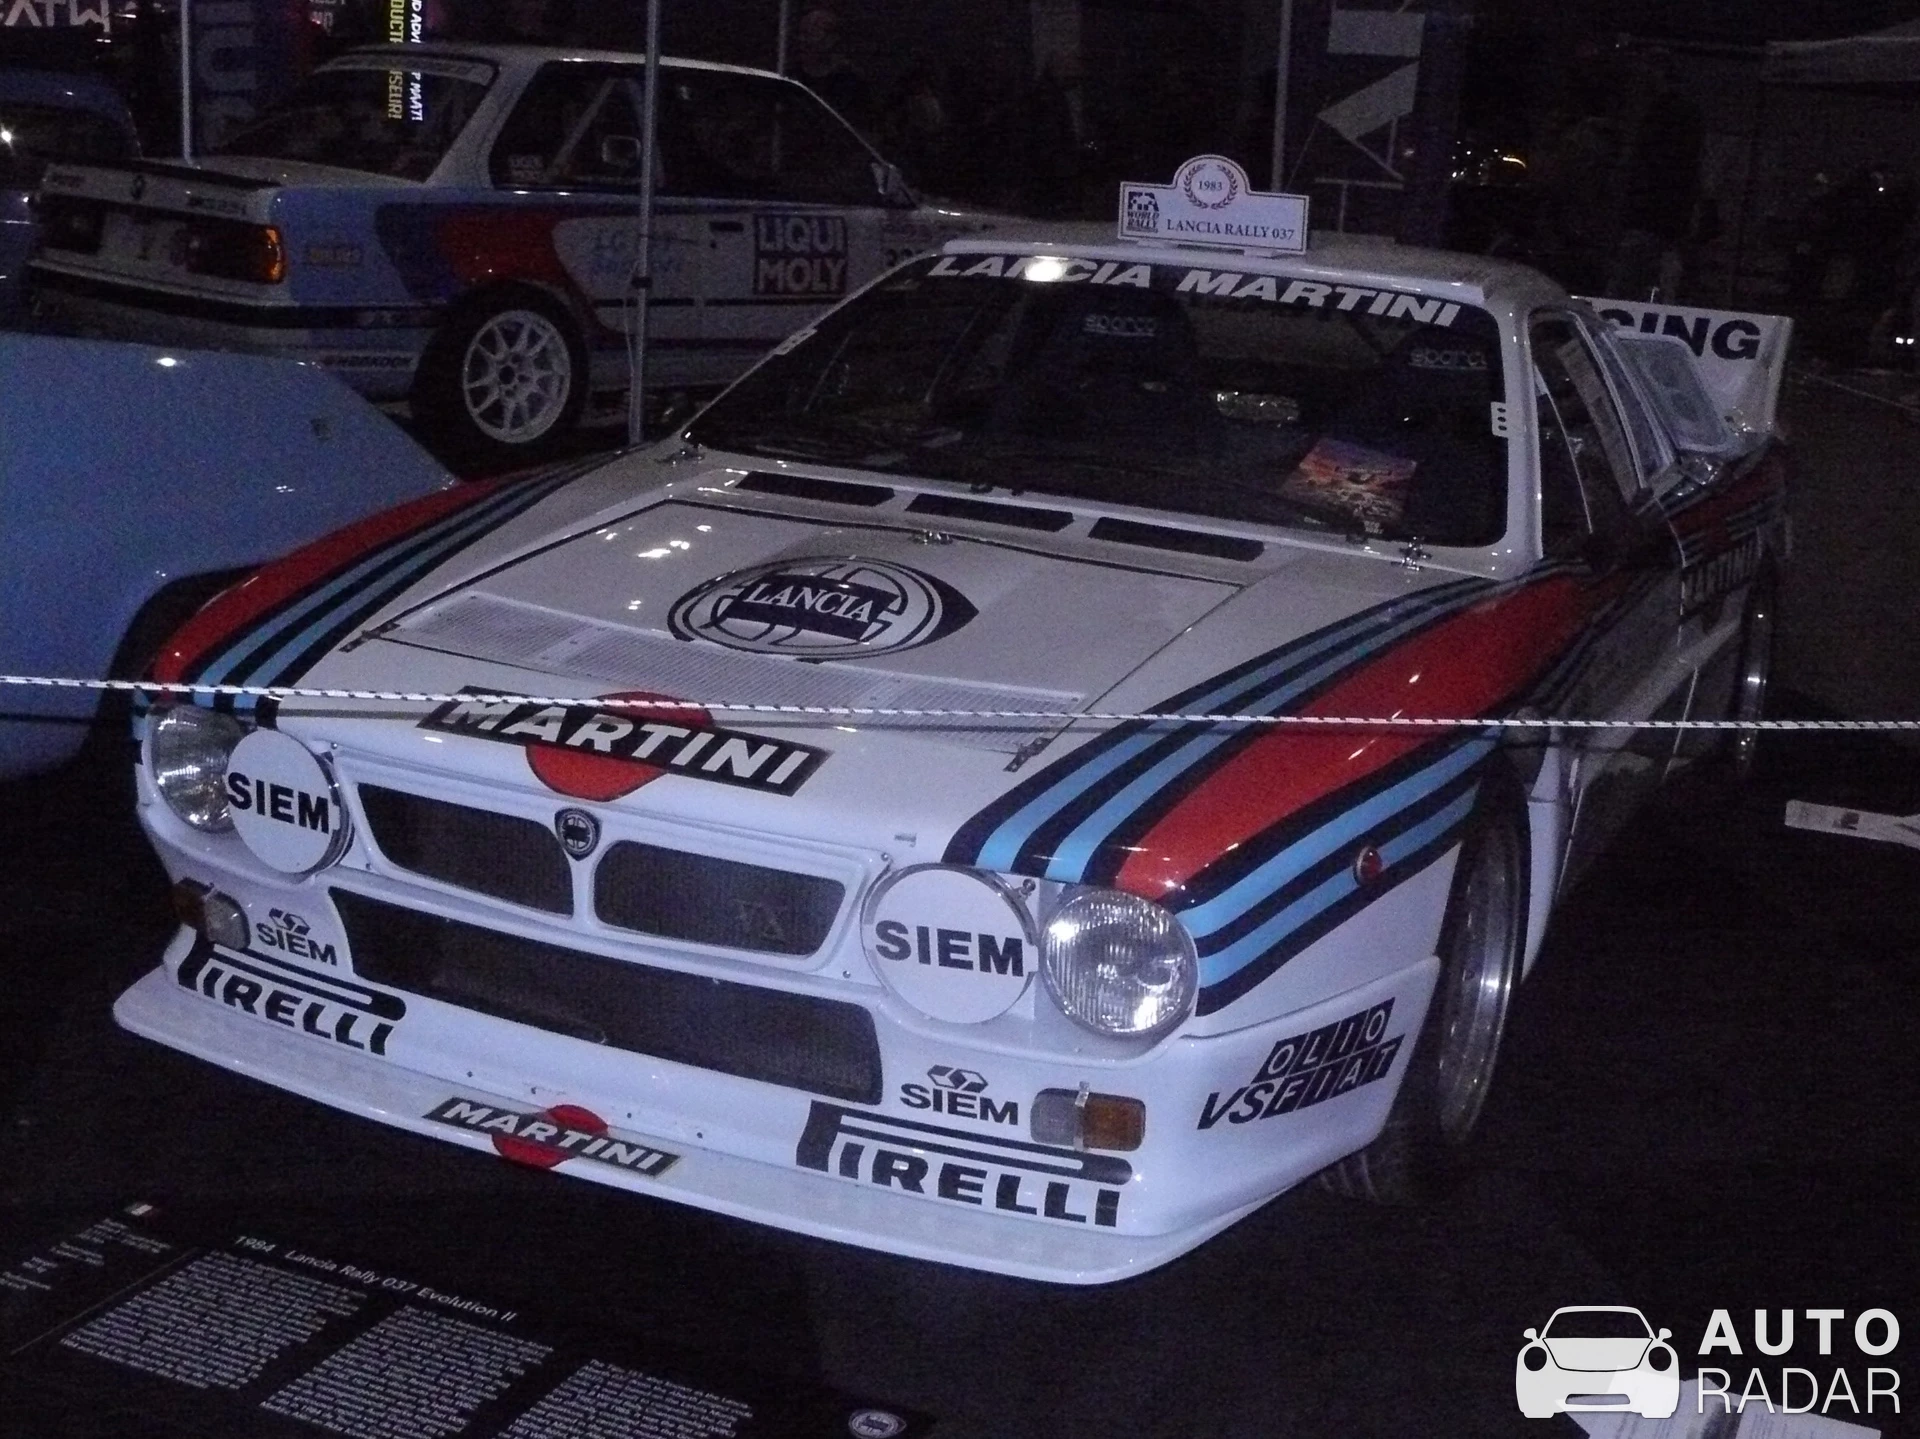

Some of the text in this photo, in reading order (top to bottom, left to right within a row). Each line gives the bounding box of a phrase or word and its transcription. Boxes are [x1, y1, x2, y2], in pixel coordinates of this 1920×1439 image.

[1199, 179, 1224, 191] 1983
[758, 218, 845, 253] LIQUI
[1126, 211, 1160, 220] WORLD
[1126, 219, 1159, 229] RALLY
[1167, 218, 1295, 241] LANCIA RALLY 037
[758, 258, 845, 293] MOLY
[928, 253, 1153, 289] LANCIA
[1175, 268, 1462, 327] MARTINI
[748, 583, 873, 623] LANCIA
[441, 697, 809, 786] MARTINI
[227, 772, 330, 834] SIEM
[256, 924, 337, 965] SIEM
[876, 921, 1024, 976] SIEM
[178, 943, 406, 1055] PIRELLI
[1267, 1007, 1387, 1076] OLIO
[901, 1083, 1020, 1126] SIEM
[442, 1101, 664, 1171] MARTINI
[797, 1100, 1133, 1226] PIRELLI
[285, 1249, 338, 1272] Lancia
[340, 1264, 380, 1284] Rally
[382, 1277, 420, 1293] 037
[417, 1286, 499, 1318] Evolution
